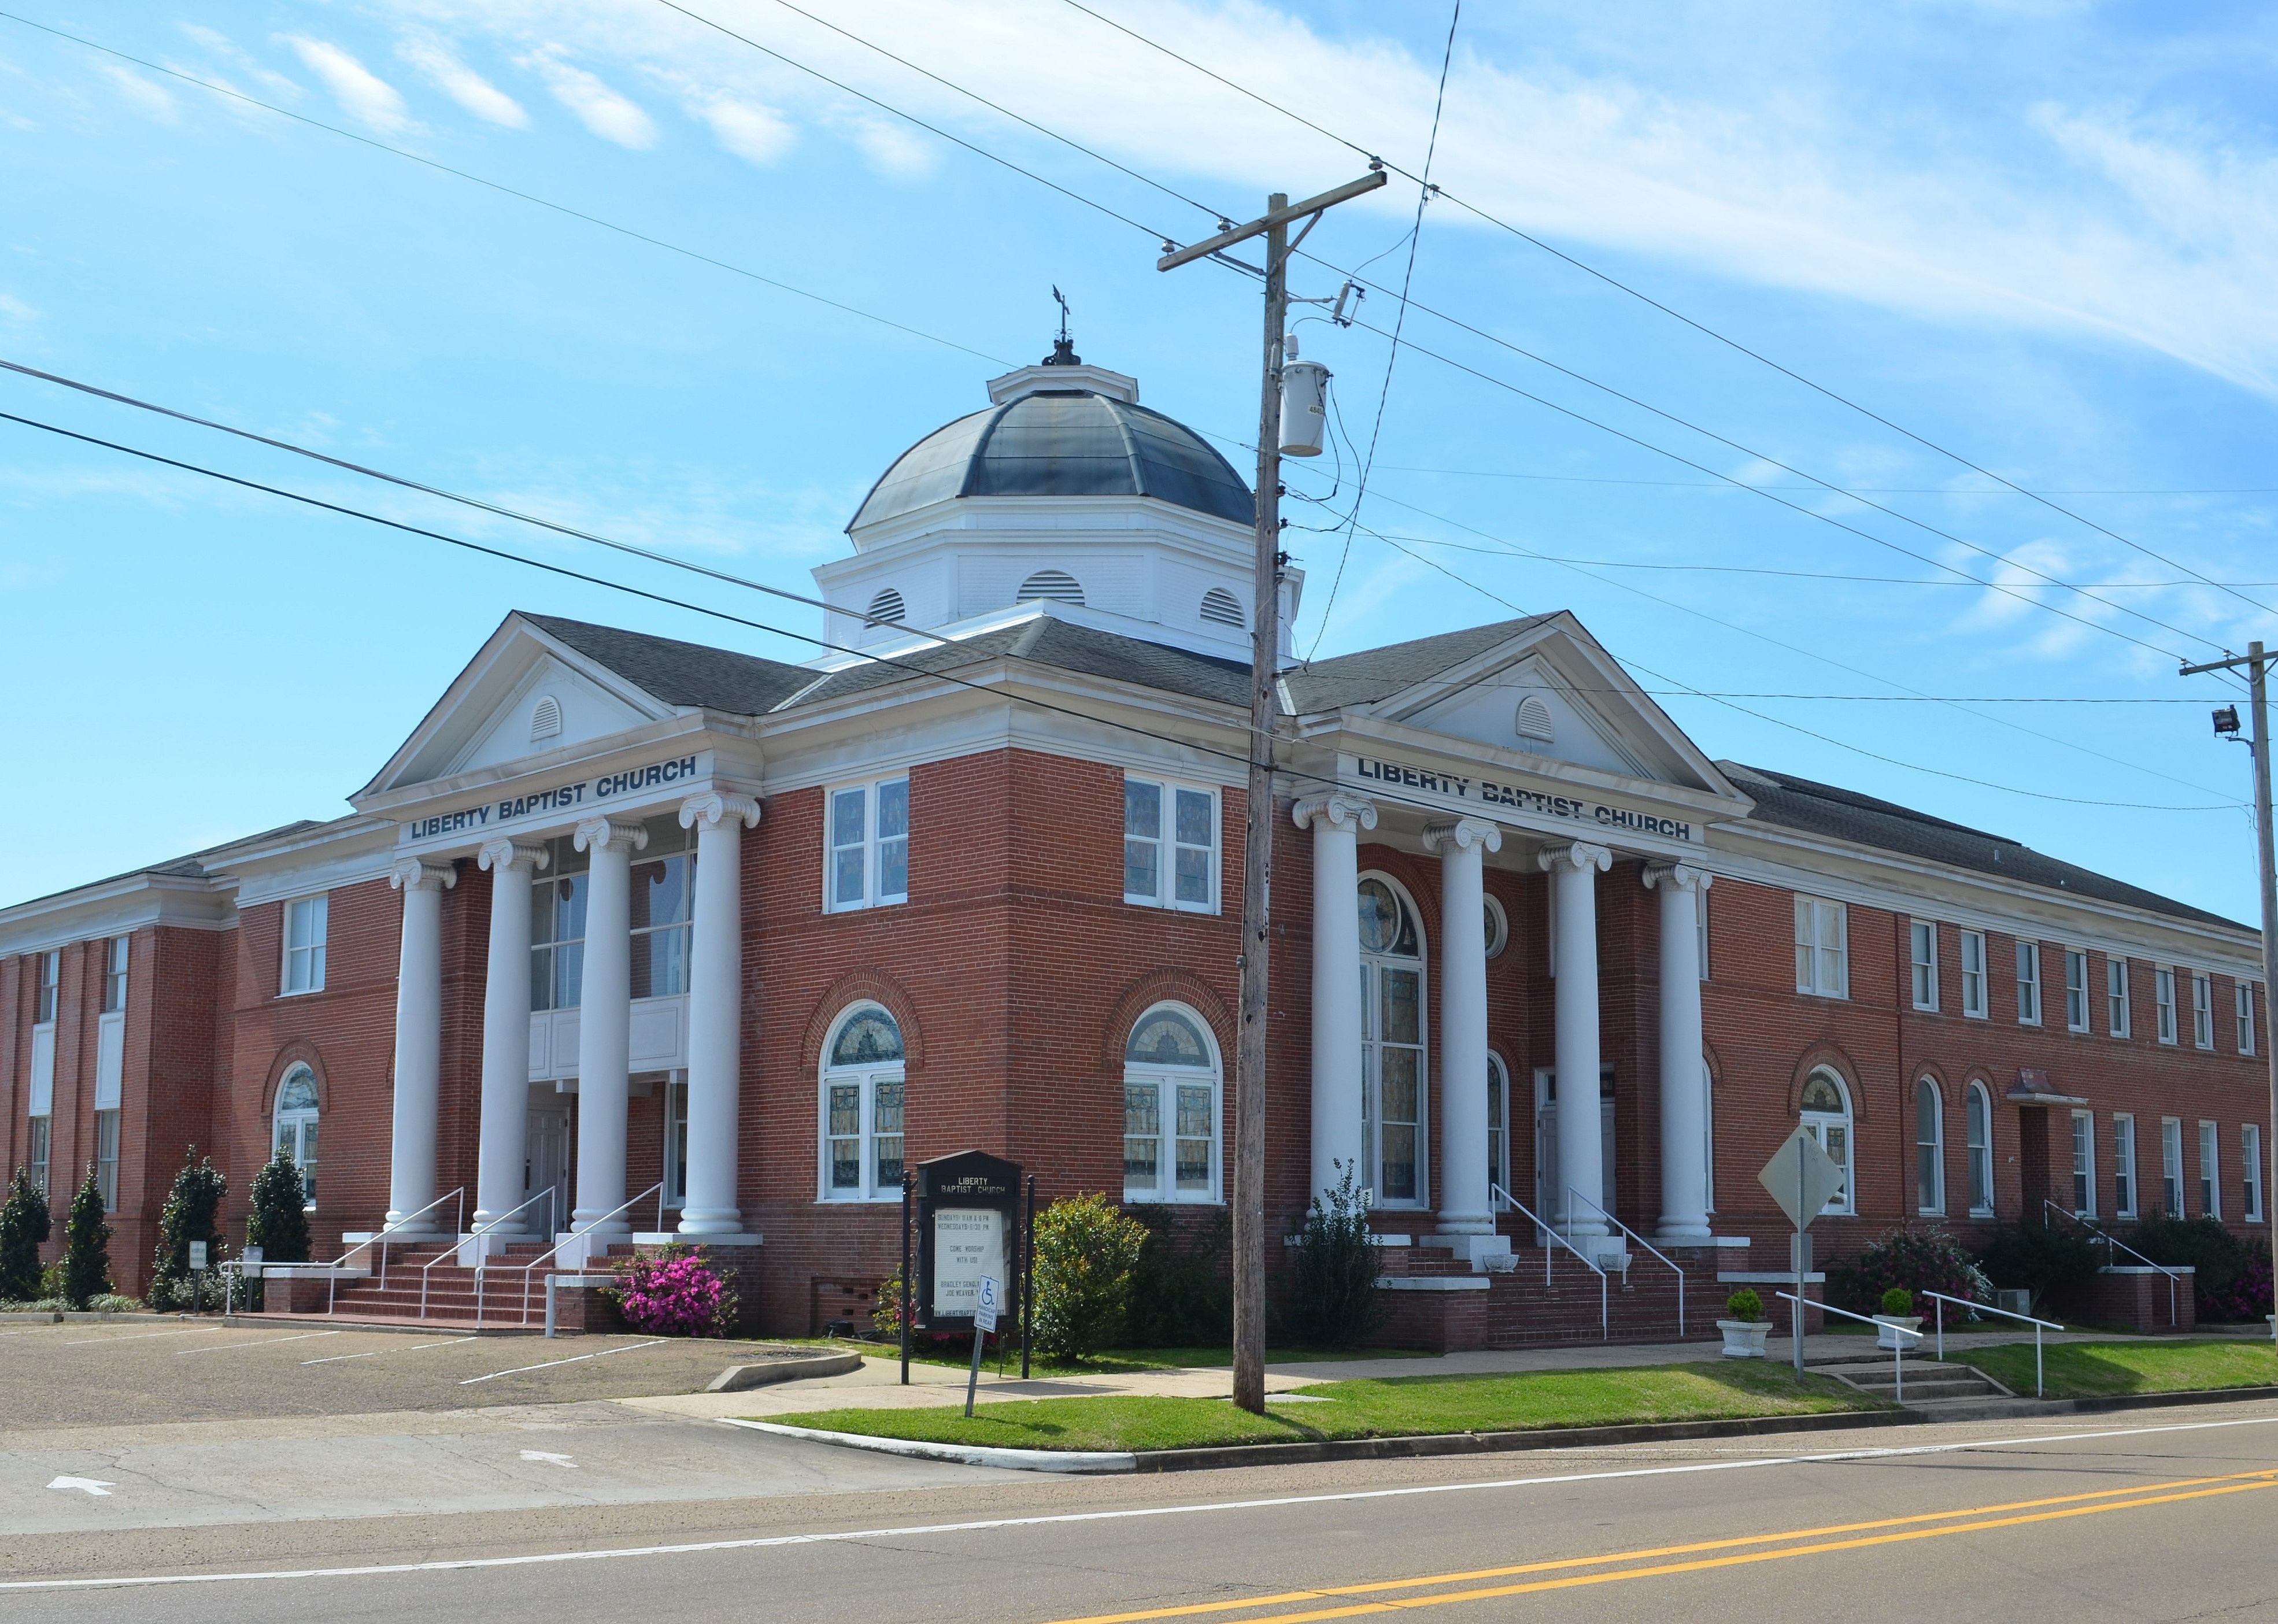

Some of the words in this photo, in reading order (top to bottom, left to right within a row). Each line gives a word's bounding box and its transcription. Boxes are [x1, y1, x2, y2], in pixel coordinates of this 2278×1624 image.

[412, 806, 490, 839] LIBERTY
[499, 783, 586, 820] BAPTIST
[597, 756, 696, 797] CHURCH
[1358, 758, 1470, 796] LIBERTY
[1482, 782, 1583, 819] BAPTIST
[1594, 806, 1689, 840] CHURCH
[958, 1177, 988, 1185] LIBERTY
[941, 1185, 971, 1193] BAPTIST
[978, 1186, 1005, 1194] CHURCH
[978, 1305, 995, 1314] HANDICAP
[979, 1310, 993, 1320] PARKING
